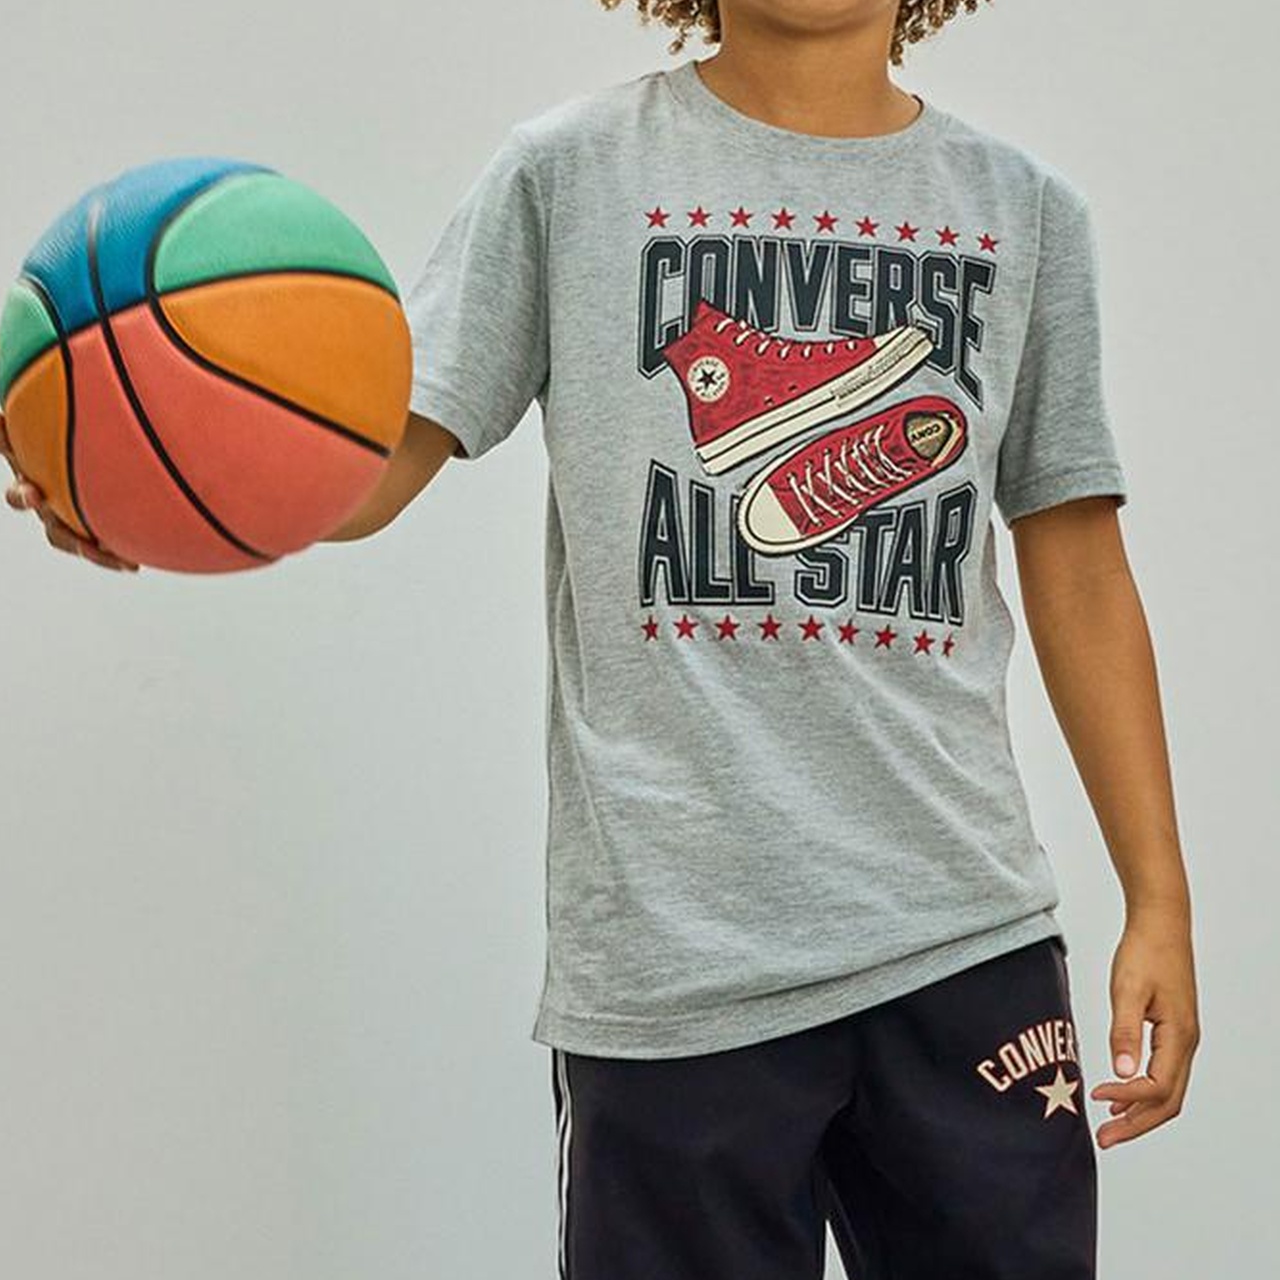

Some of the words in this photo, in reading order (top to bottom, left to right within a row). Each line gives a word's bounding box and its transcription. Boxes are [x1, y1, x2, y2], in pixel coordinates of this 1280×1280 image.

[638, 235, 997, 410] CONVERSE
[640, 459, 775, 608] ALL
[794, 480, 978, 626] STAR
